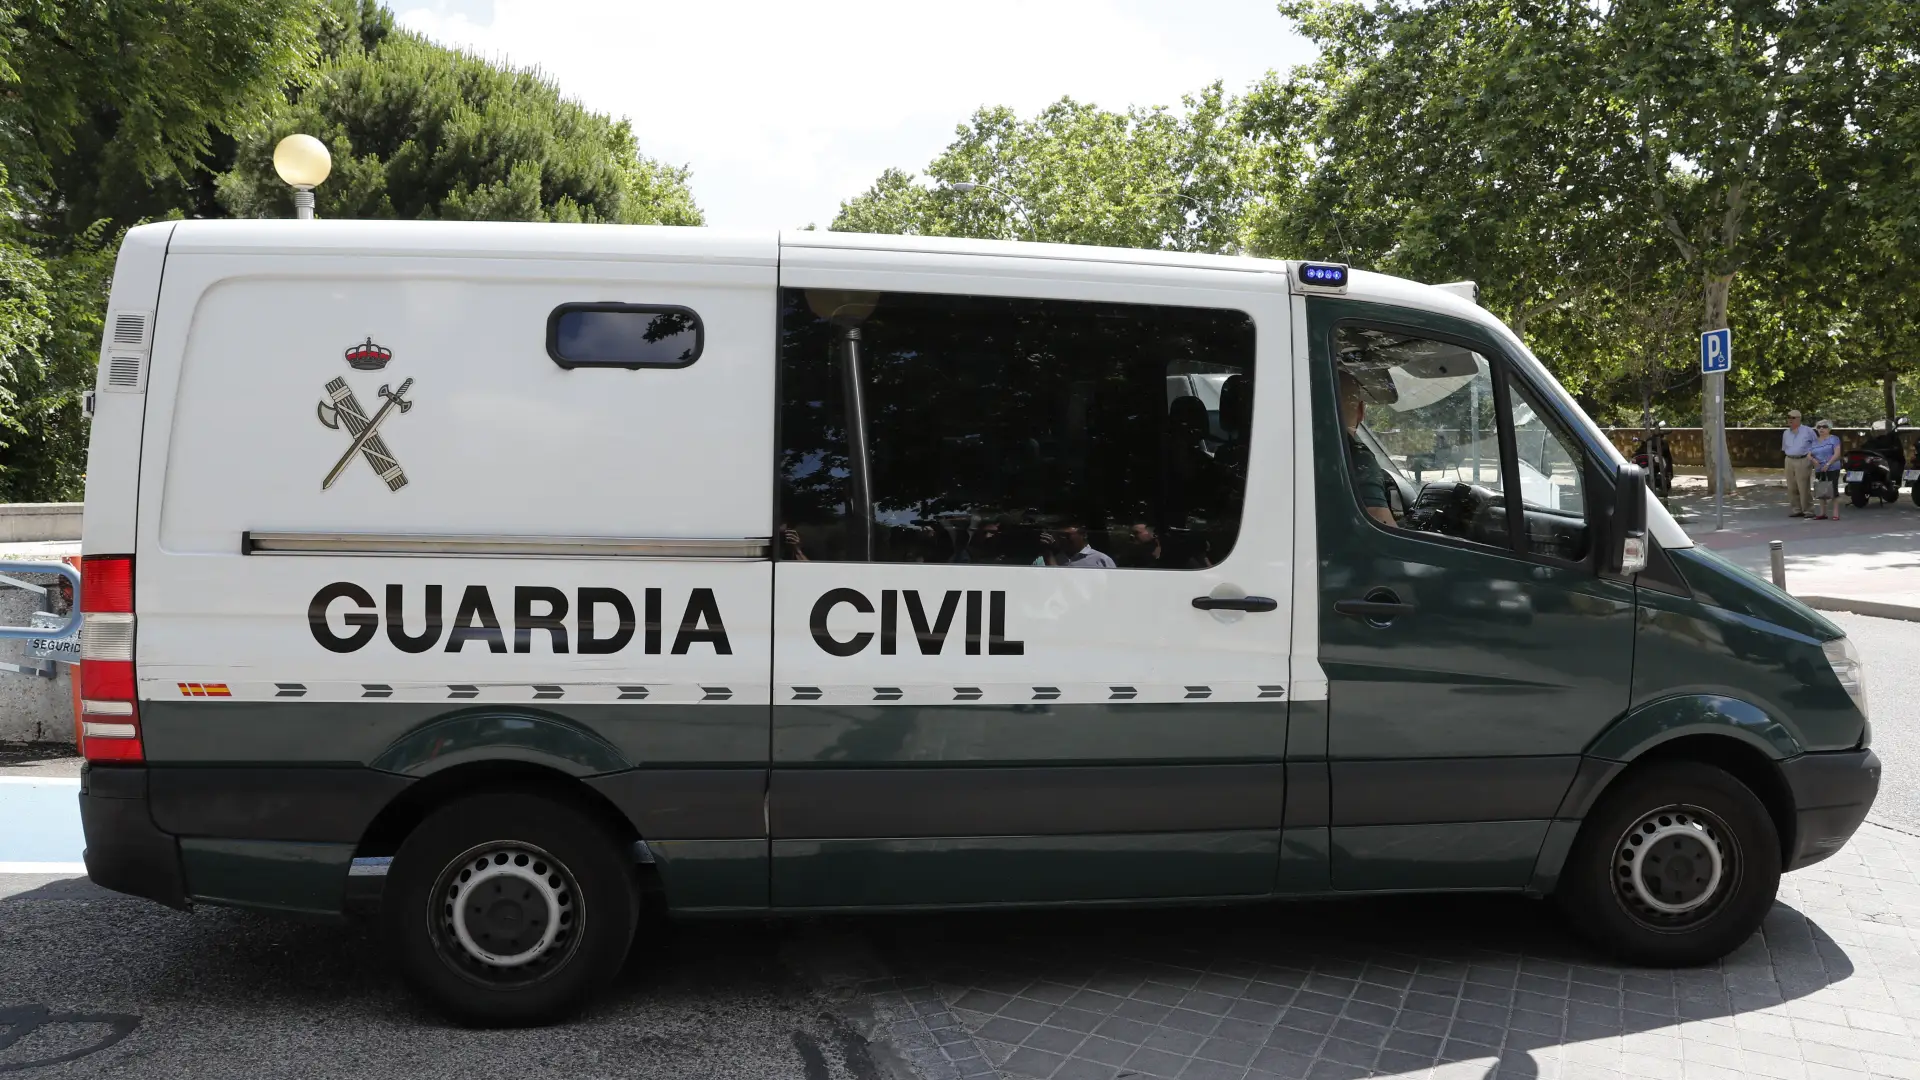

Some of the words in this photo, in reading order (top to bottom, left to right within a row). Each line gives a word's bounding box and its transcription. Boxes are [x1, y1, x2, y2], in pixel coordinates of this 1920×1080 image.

[1708, 334, 1720, 367] P
[308, 581, 733, 655] GUARDIA
[809, 587, 1025, 657] CIVIL
